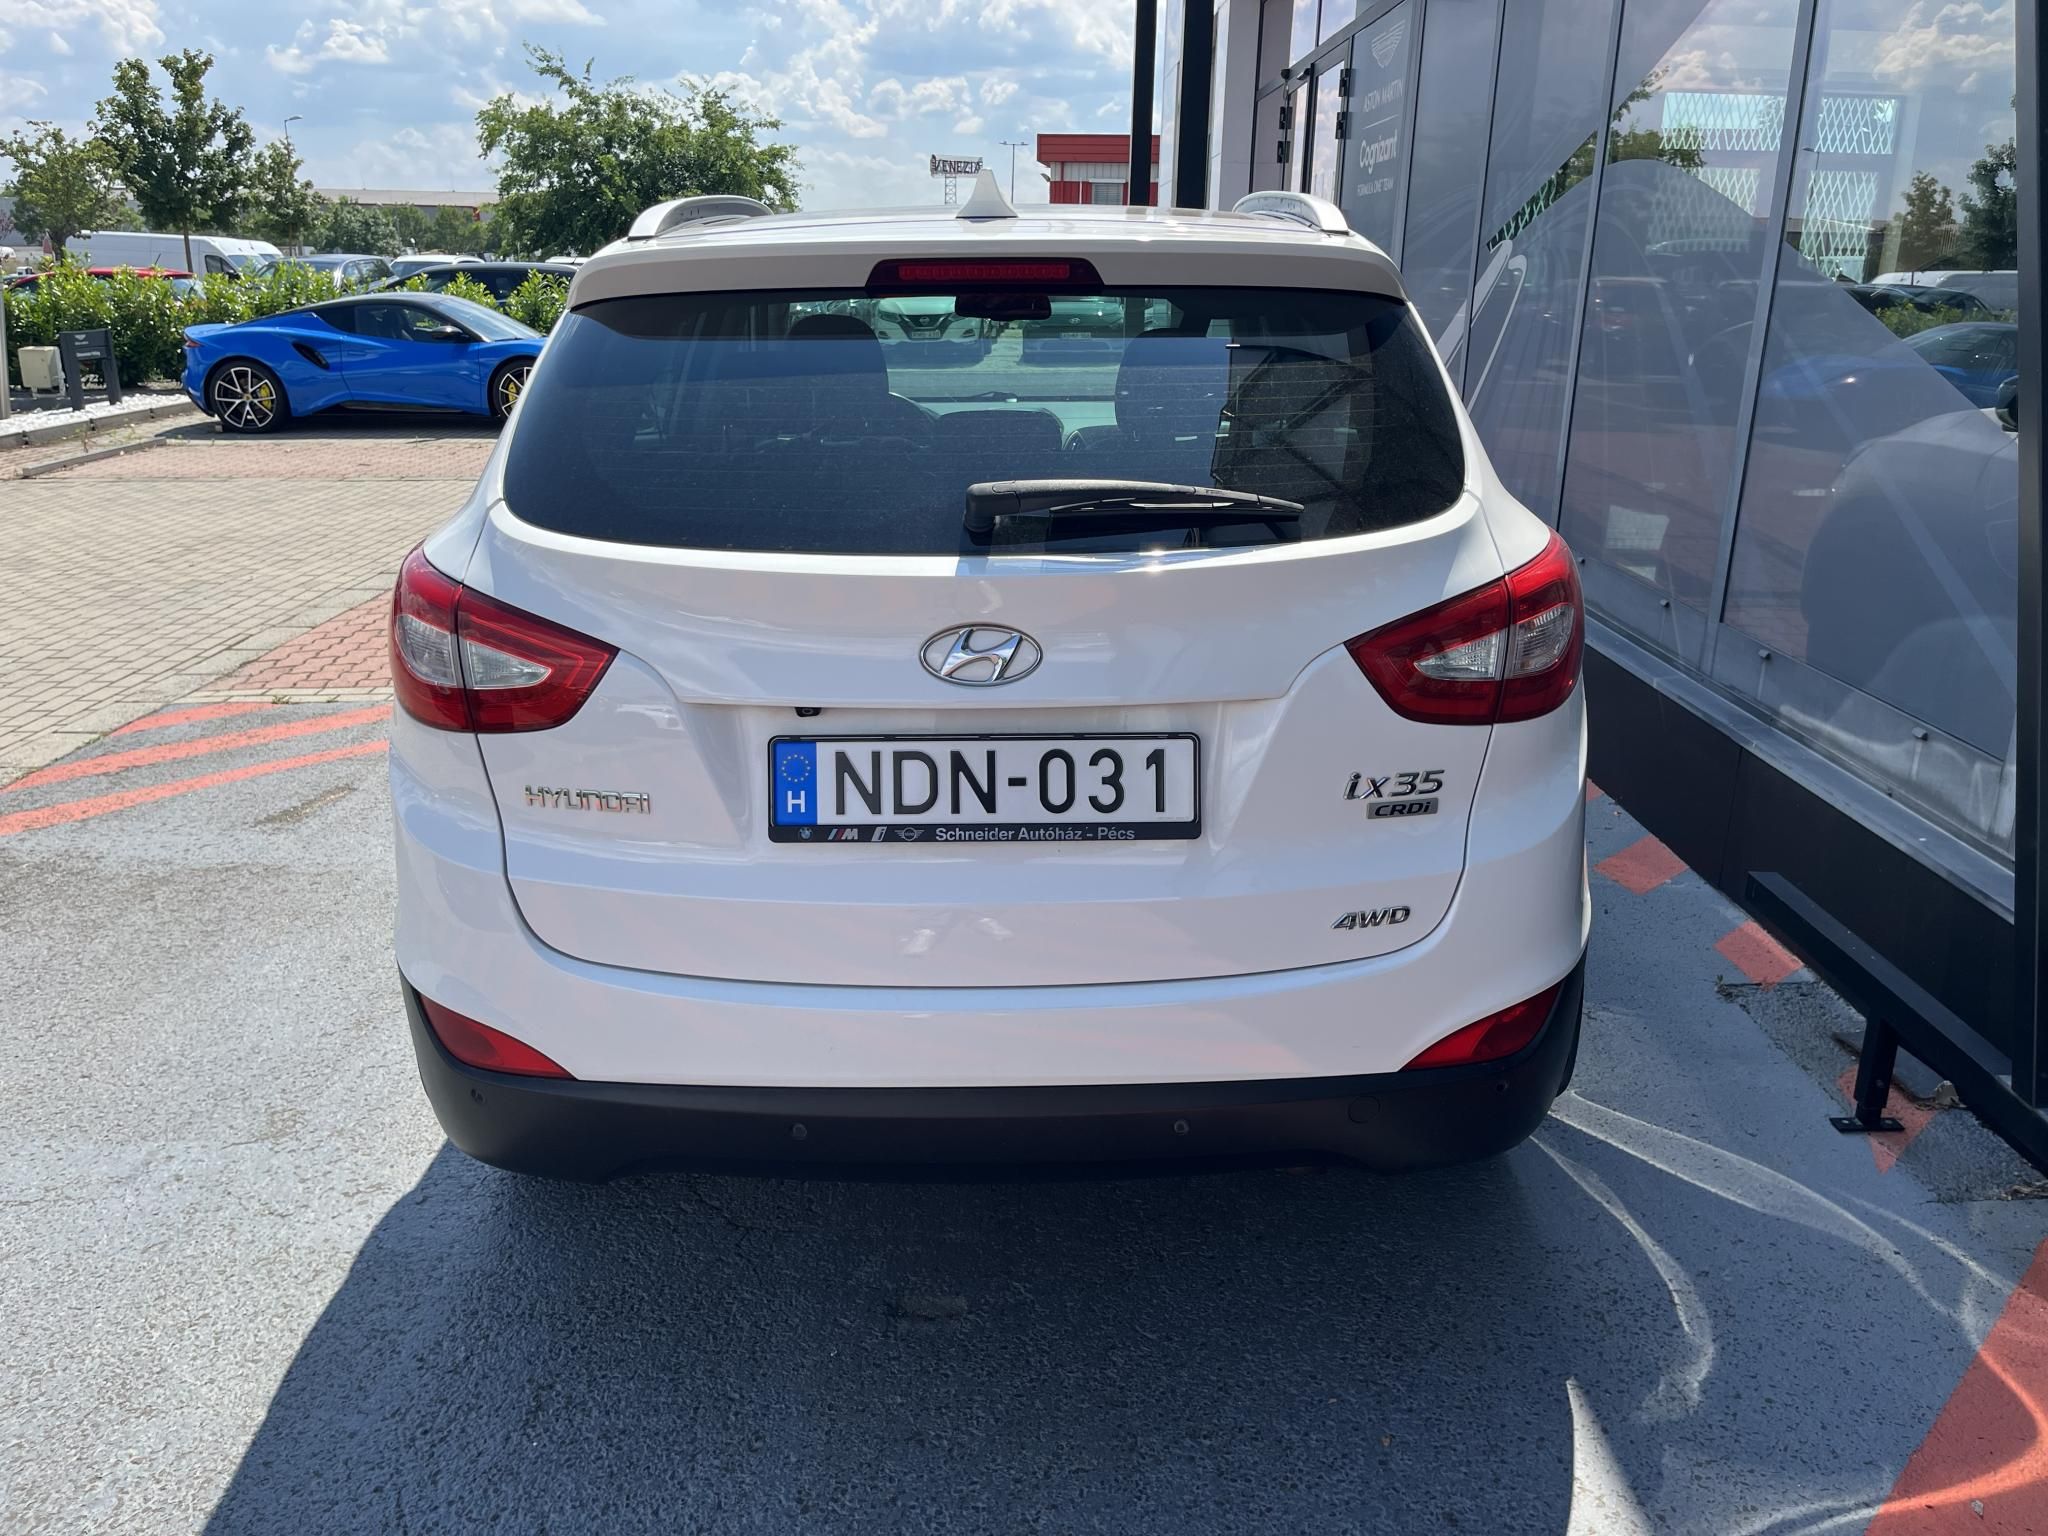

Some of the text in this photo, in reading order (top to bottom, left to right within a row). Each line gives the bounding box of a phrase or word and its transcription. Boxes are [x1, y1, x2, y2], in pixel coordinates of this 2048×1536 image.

[1359, 129, 1398, 175] Cognizant
[835, 748, 1166, 815] NDN-031
[1344, 770, 1445, 800] ix35
[525, 785, 650, 814] HYUNDAI
[787, 790, 806, 813] H
[935, 827, 1015, 841] Schneider
[1017, 827, 1083, 841] Autóház
[1097, 826, 1135, 840] Pécs
[1331, 906, 1410, 930] 4WD
